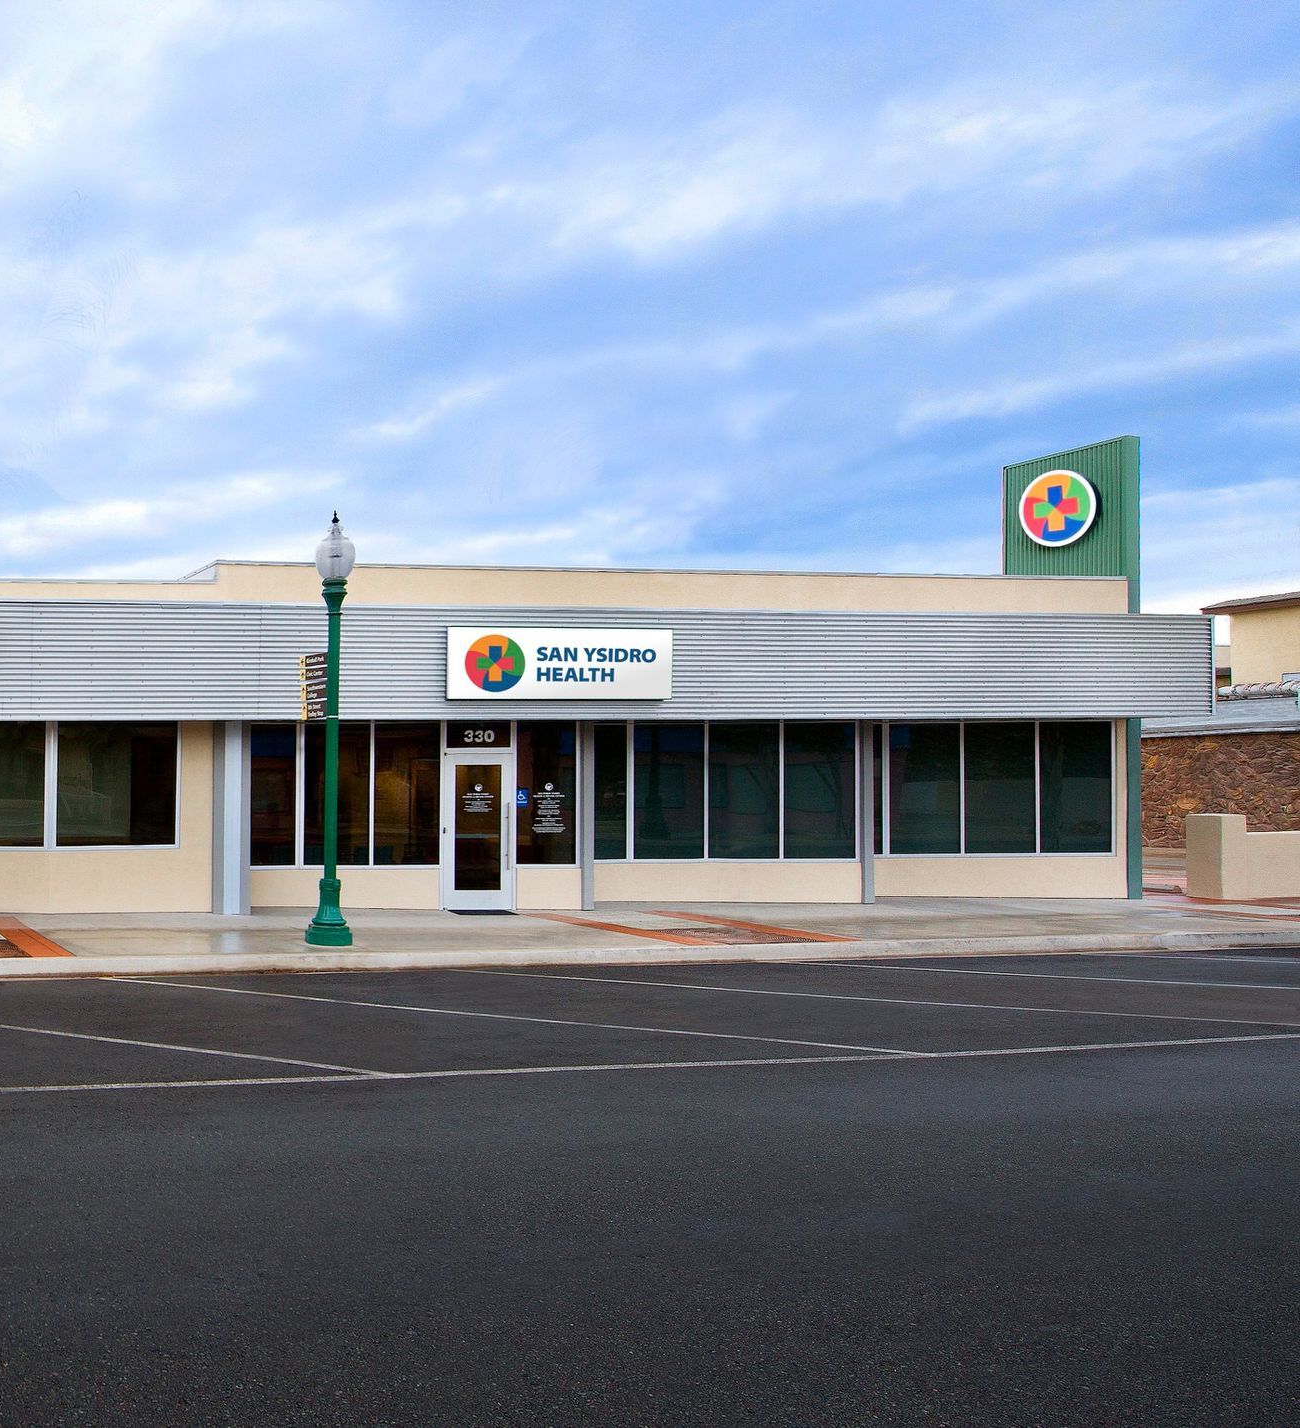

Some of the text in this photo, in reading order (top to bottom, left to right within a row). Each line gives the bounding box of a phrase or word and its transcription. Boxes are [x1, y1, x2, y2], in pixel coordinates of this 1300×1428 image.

[536, 646, 657, 664] SAN YSIDRO
[536, 667, 615, 682] HEALTH
[463, 730, 495, 743] 330
